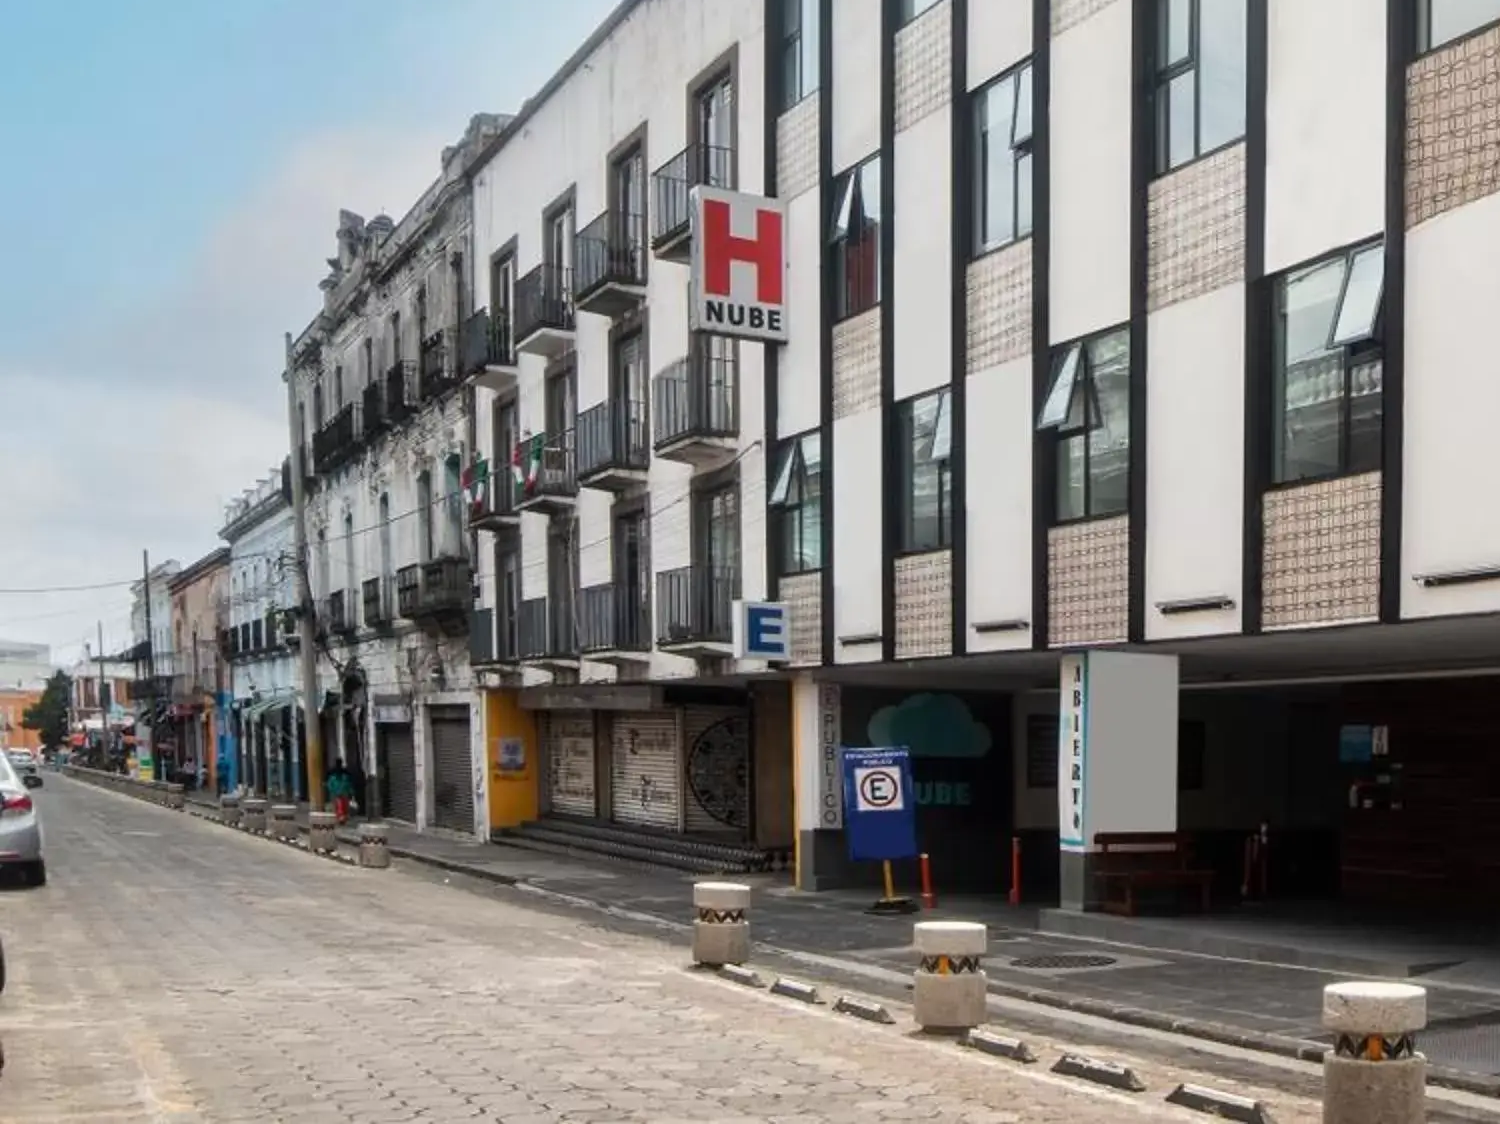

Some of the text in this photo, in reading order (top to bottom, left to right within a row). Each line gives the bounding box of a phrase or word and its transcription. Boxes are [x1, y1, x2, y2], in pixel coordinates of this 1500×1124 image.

[703, 199, 783, 305] H
[705, 300, 782, 331] NUBE
[747, 607, 785, 653] E
[823, 713, 837, 825] PUBLICO
[1071, 665, 1082, 829] ABIERTO
[869, 777, 889, 800] E
[913, 780, 971, 805] UBE
